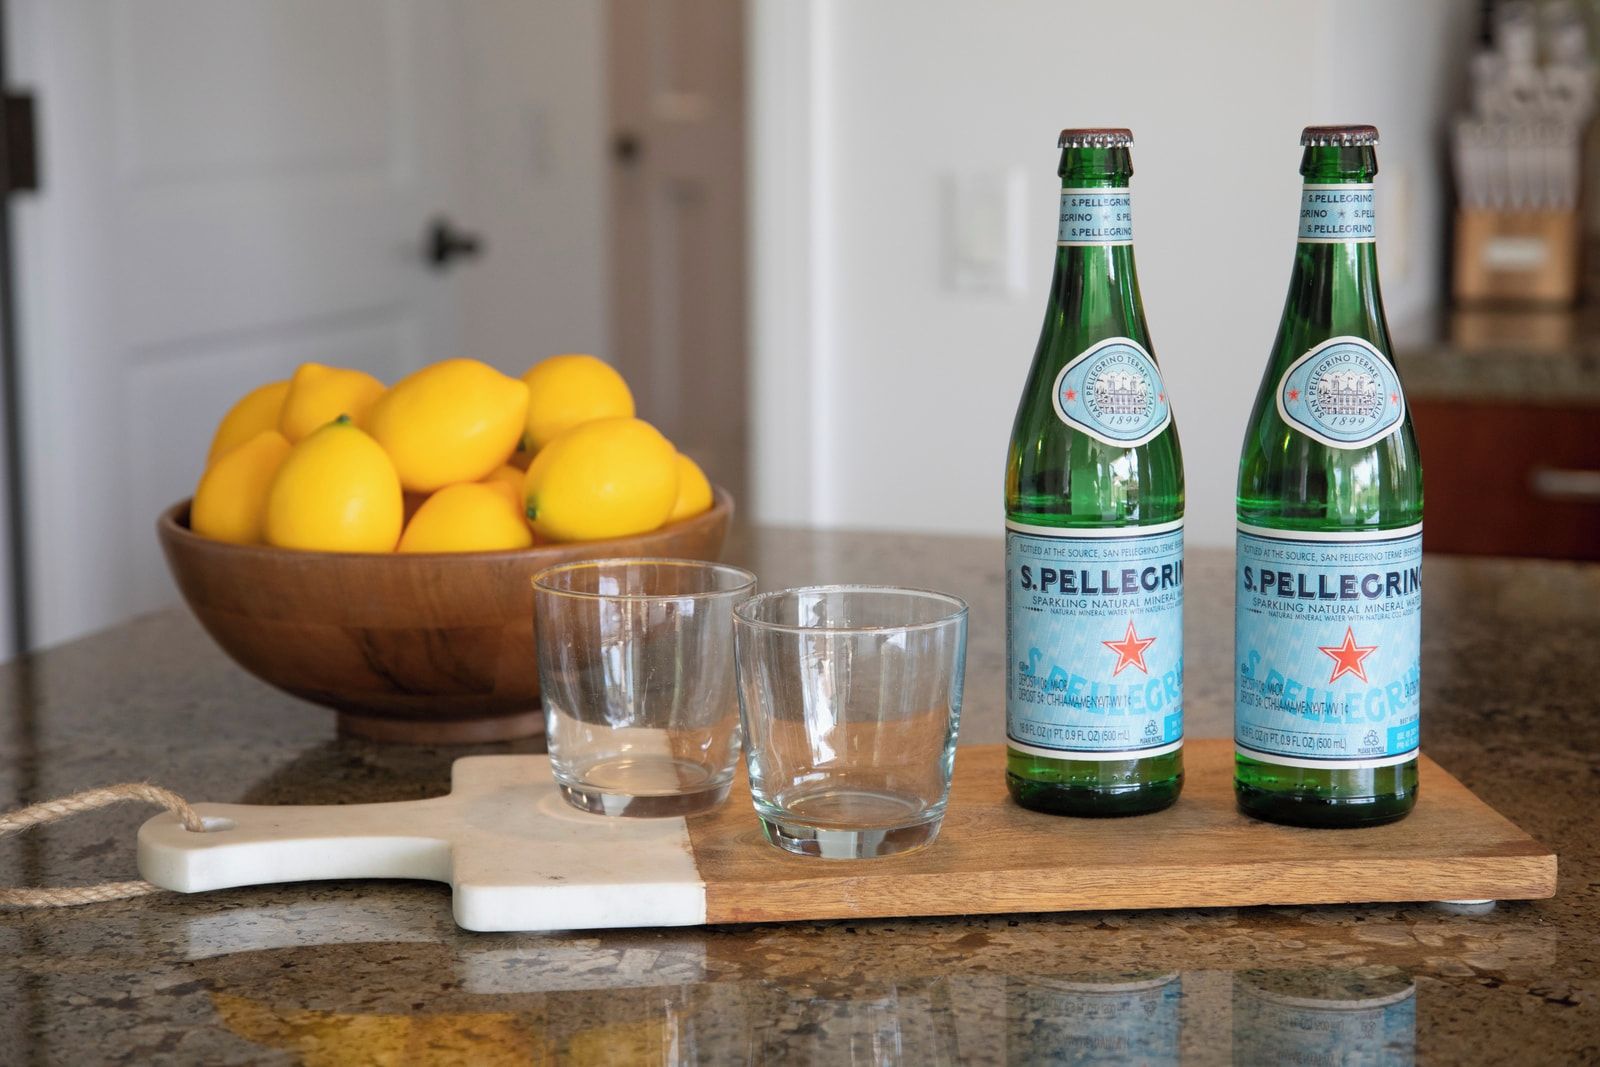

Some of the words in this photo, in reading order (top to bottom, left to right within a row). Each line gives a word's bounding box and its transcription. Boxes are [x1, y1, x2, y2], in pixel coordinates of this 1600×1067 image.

[1308, 194, 1371, 203] S.PELLEGRINO
[1307, 224, 1371, 233] S.PELLEGRINO
[1127, 356, 1148, 377] TERME
[1355, 355, 1379, 379] TERME
[1086, 355, 1125, 396] PELLEGRINO
[1308, 354, 1351, 396] PELLEGRINO
[1087, 399, 1103, 418] SAN
[1310, 399, 1325, 418] SAN
[1370, 392, 1384, 419] ITALIA
[1110, 415, 1140, 425] 1899
[1331, 416, 1365, 425] 1899
[1044, 547, 1052, 556] AT
[1054, 548, 1065, 557] THE
[1103, 549, 1119, 558] SAN
[1264, 549, 1271, 558] AT
[1272, 550, 1284, 559] THE
[1286, 551, 1318, 562] SOURCE,
[1320, 553, 1338, 562] SAN
[1340, 552, 1383, 562] PELLEGRINO
[1385, 549, 1402, 560] TERME
[1033, 595, 1087, 608] SPARKLING
[1092, 599, 1140, 609] NATURAL
[1144, 593, 1176, 606] MINERAL
[1253, 597, 1304, 613] SPARKLING
[1308, 604, 1360, 614] NATURAL
[1364, 601, 1404, 613] MINERAL
[1269, 611, 1293, 619] NATURAL
[1295, 613, 1323, 621] MINERAL
[1037, 727, 1046, 737] OZ
[1065, 729, 1075, 740] 0.9
[1077, 730, 1086, 741] FL
[1255, 730, 1263, 741] OZ
[1281, 735, 1291, 746] 0.9
[1293, 737, 1301, 747] FL
[1316, 738, 1331, 750] (500
